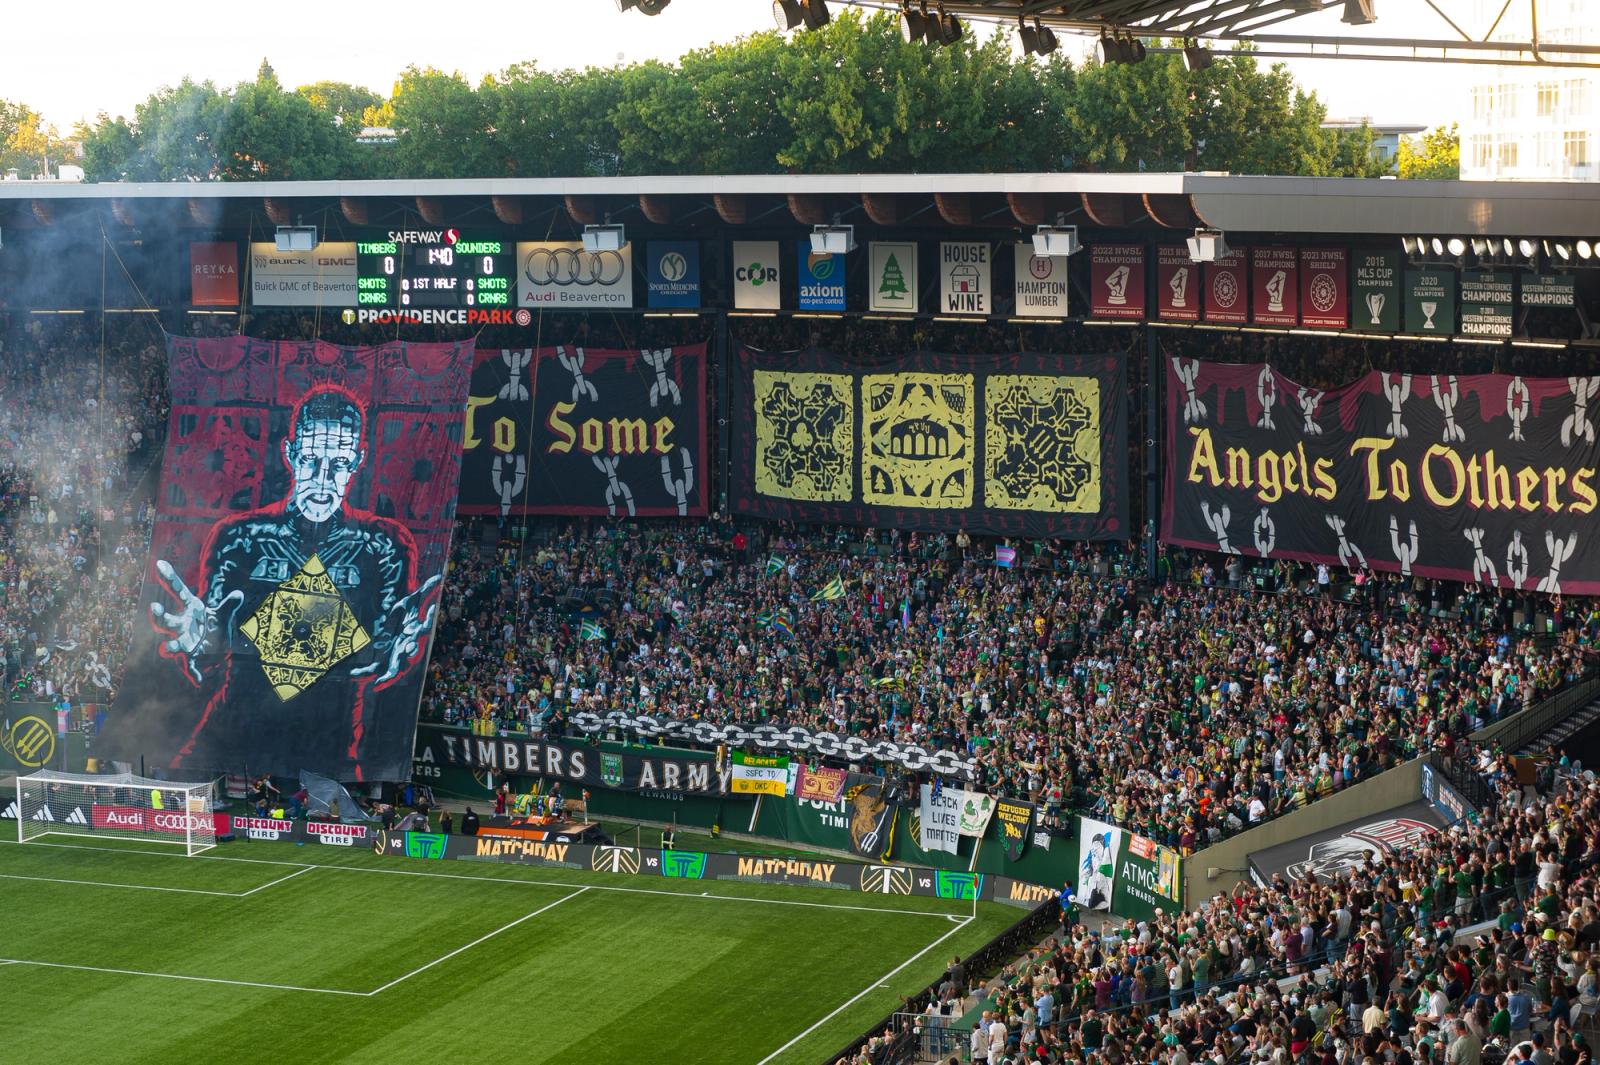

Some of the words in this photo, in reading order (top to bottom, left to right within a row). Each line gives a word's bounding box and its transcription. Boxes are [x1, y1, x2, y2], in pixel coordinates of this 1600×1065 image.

[388, 231, 443, 244] SAFEWAY
[358, 243, 396, 254] TIMBERS
[456, 243, 501, 254] SOUNDERS
[944, 245, 986, 263] HOUSE
[1115, 247, 1141, 255] NWSL
[1175, 248, 1191, 256] NW
[1255, 250, 1271, 259] 2017
[1273, 250, 1295, 259] NWSL
[1302, 252, 1319, 260] 2021
[1321, 252, 1344, 260] NWSL
[318, 258, 356, 266] GMC
[384, 256, 395, 275] 0
[483, 256, 493, 275] 0
[1255, 261, 1295, 269] CHAMPIONS
[1310, 262, 1336, 270] SHIELD
[1366, 257, 1385, 267] 2015
[195, 264, 235, 274] REYKA
[1357, 268, 1375, 278] MLS
[1376, 268, 1393, 279] CUP
[255, 282, 276, 291] Buick
[279, 282, 300, 291] GMC
[302, 282, 311, 291] of
[313, 282, 357, 292] Beaverton
[358, 278, 387, 289] SHOTS
[413, 278, 430, 289] 1ST
[434, 278, 457, 289] HALF
[478, 278, 507, 289] SHOTS
[1420, 277, 1438, 286] 2020
[1462, 282, 1483, 290] WESTERN
[1484, 283, 1512, 291] CONFERENCE
[800, 283, 844, 298] axiom
[1017, 281, 1066, 295] HAMPTON
[1522, 284, 1544, 292] WESTERN
[1545, 285, 1574, 294] CONFERENCE
[358, 293, 387, 304] CRNRS
[478, 293, 508, 304] CRNRS
[525, 291, 556, 301] Audi
[560, 291, 626, 302] Beaverton
[1024, 296, 1059, 307] LUMBER
[1462, 291, 1512, 303] CHAMPIONS
[1522, 293, 1574, 305] CHAMPIONS
[948, 294, 984, 311] WINE
[358, 309, 467, 325] PROVIDENCE
[467, 309, 514, 324] PARK
[1462, 314, 1483, 322] WESTERN
[1484, 315, 1512, 324] CONFERENCE
[1462, 323, 1512, 335] CHAMPIONS
[464, 395, 516, 453] To
[548, 401, 675, 454] Some
[1187, 427, 1337, 503] Angels
[1350, 437, 1411, 502] To
[1421, 444, 1598, 514] Others
[443, 735, 586, 778] TIMBERS
[639, 760, 732, 793] ARMY
[745, 769, 763, 777] SSFC
[998, 802, 1031, 816] REFUGEES
[106, 811, 143, 825] Audi
[932, 811, 956, 826] LIVES
[234, 816, 293, 832] DISCOUNT
[251, 829, 276, 838] TIRE
[307, 822, 368, 838] DISCOUNT
[324, 835, 350, 844] TIRE
[391, 838, 402, 848] VS
[476, 838, 569, 862] MATCHDAY
[646, 857, 658, 867] VS
[738, 857, 836, 882] MATCHDAY
[919, 877, 931, 888] VS
[1127, 885, 1156, 905] REWARDS
